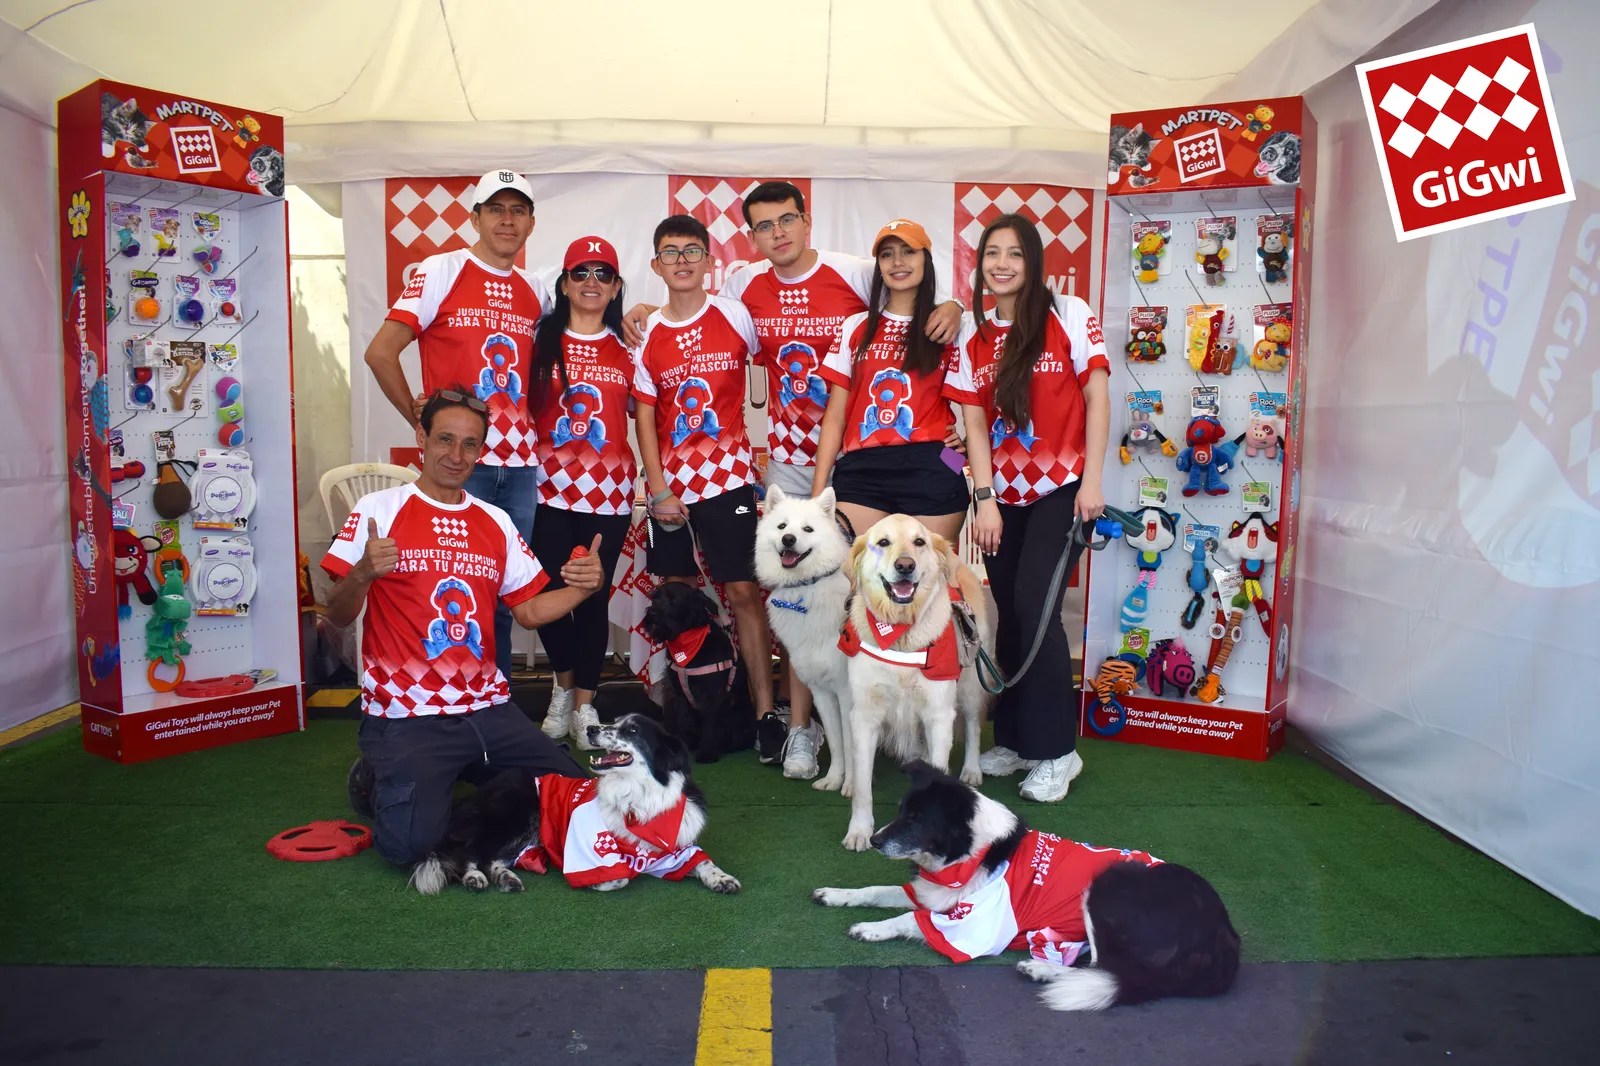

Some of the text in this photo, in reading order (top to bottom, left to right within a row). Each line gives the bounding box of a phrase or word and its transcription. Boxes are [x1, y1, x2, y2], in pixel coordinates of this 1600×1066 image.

[156, 100, 234, 132] MARTPET
[1161, 109, 1242, 136] MARTPET
[184, 154, 213, 166] GiGwi
[1186, 156, 1216, 172] GiGwi
[488, 299, 512, 310] GiGwi
[782, 306, 808, 315] GiGwi
[456, 308, 499, 319] JUGUETES
[448, 317, 480, 327] PARA
[484, 318, 496, 329] TU
[773, 326, 789, 337] TU
[692, 352, 732, 363] PREMIUM
[874, 350, 889, 360] TU
[690, 360, 739, 374] MASCOTA
[438, 537, 468, 548] GiGwi
[401, 549, 496, 568] JUGUETES PREMIUM
[434, 560, 448, 572] TU
[146, 700, 281, 731] GiGwi Toys will always keep your Pet
[1127, 707, 1144, 718] Toys
[1145, 710, 1159, 719] will
[1159, 712, 1187, 724] always
[1188, 715, 1208, 726] keep
[1208, 720, 1228, 728] your
[1229, 721, 1243, 730] Pet
[154, 724, 201, 740] entertained
[202, 720, 223, 730] while
[224, 719, 238, 729] you
[252, 710, 275, 721] away!
[1155, 722, 1177, 732] while
[1177, 725, 1193, 734] you
[1209, 731, 1234, 740] away!
